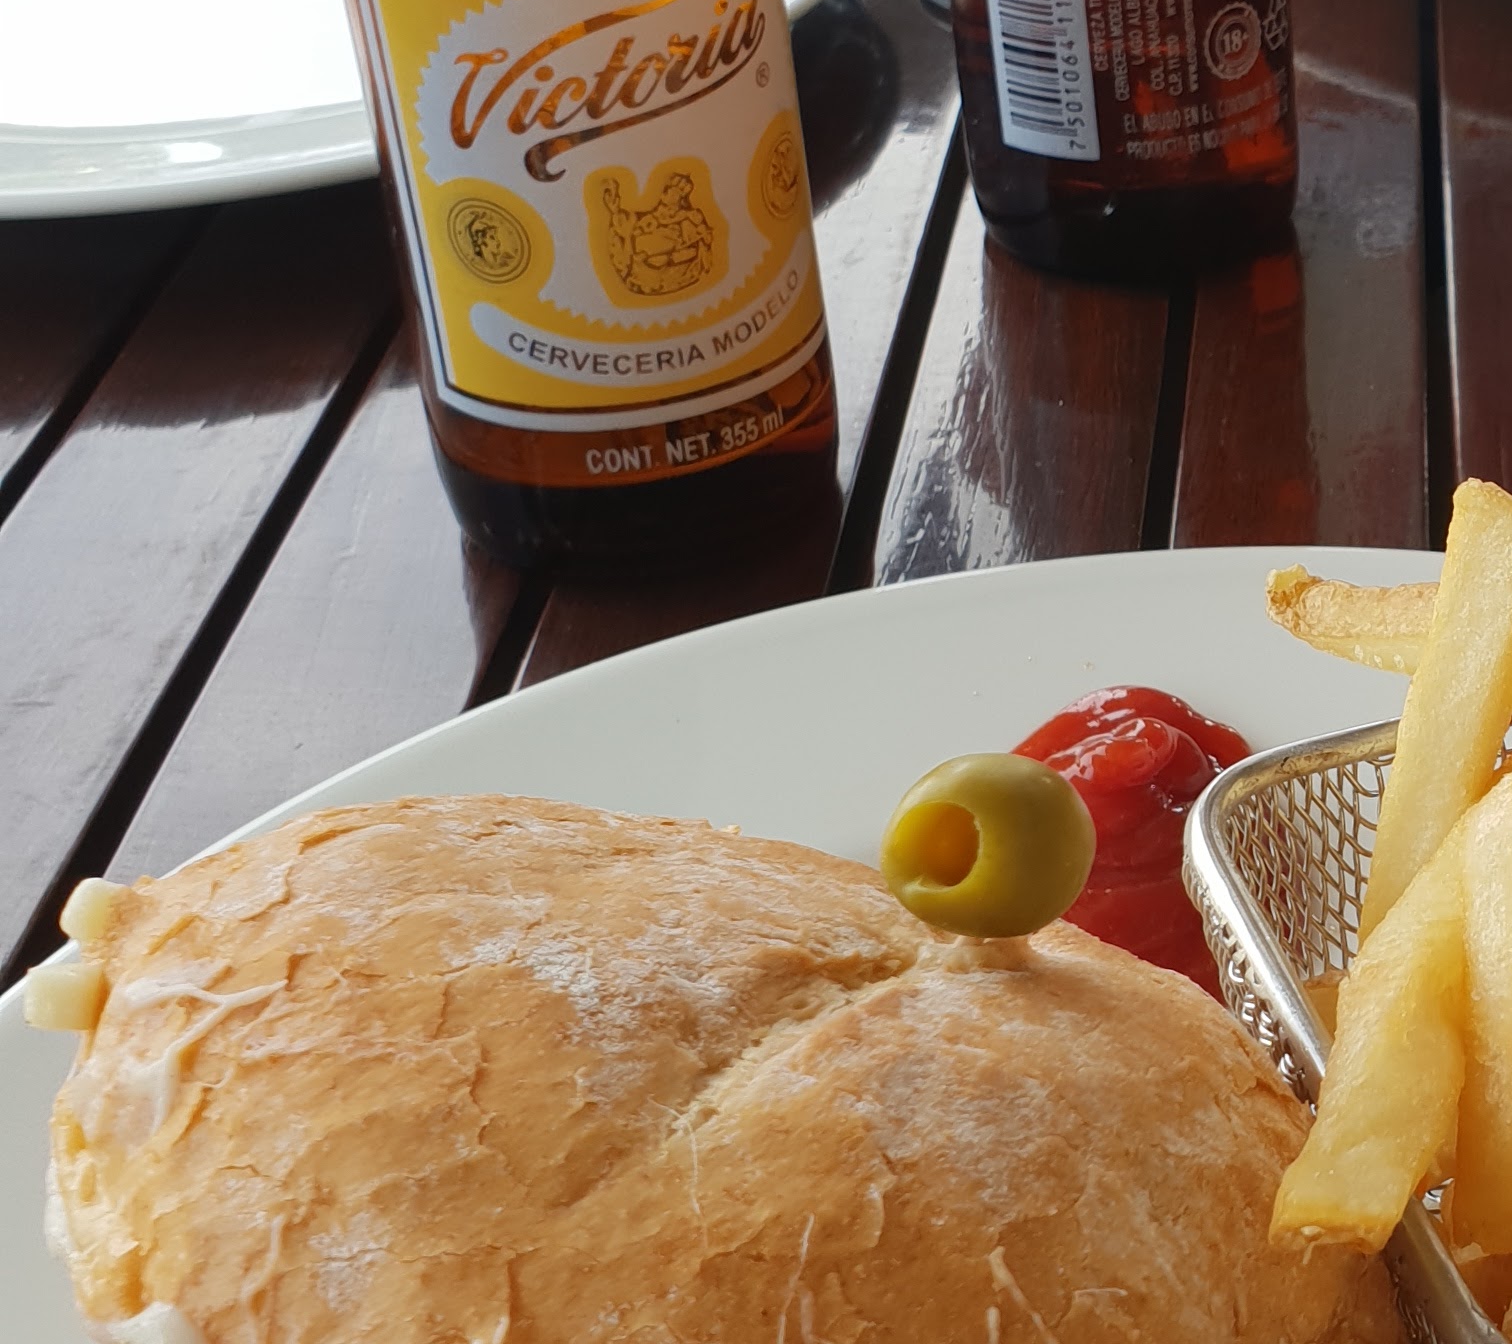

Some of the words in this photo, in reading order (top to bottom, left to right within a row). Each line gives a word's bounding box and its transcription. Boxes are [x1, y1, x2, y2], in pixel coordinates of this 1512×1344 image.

[1058, 39, 1086, 130] 501064
[1128, 30, 1145, 66] LAGO
[508, 331, 705, 376] CERVECERIA
[711, 268, 799, 356] MODELO
[585, 446, 660, 475] CONT.
[666, 432, 717, 464] NET.
[721, 418, 760, 451] 355
[763, 406, 784, 434] ml
